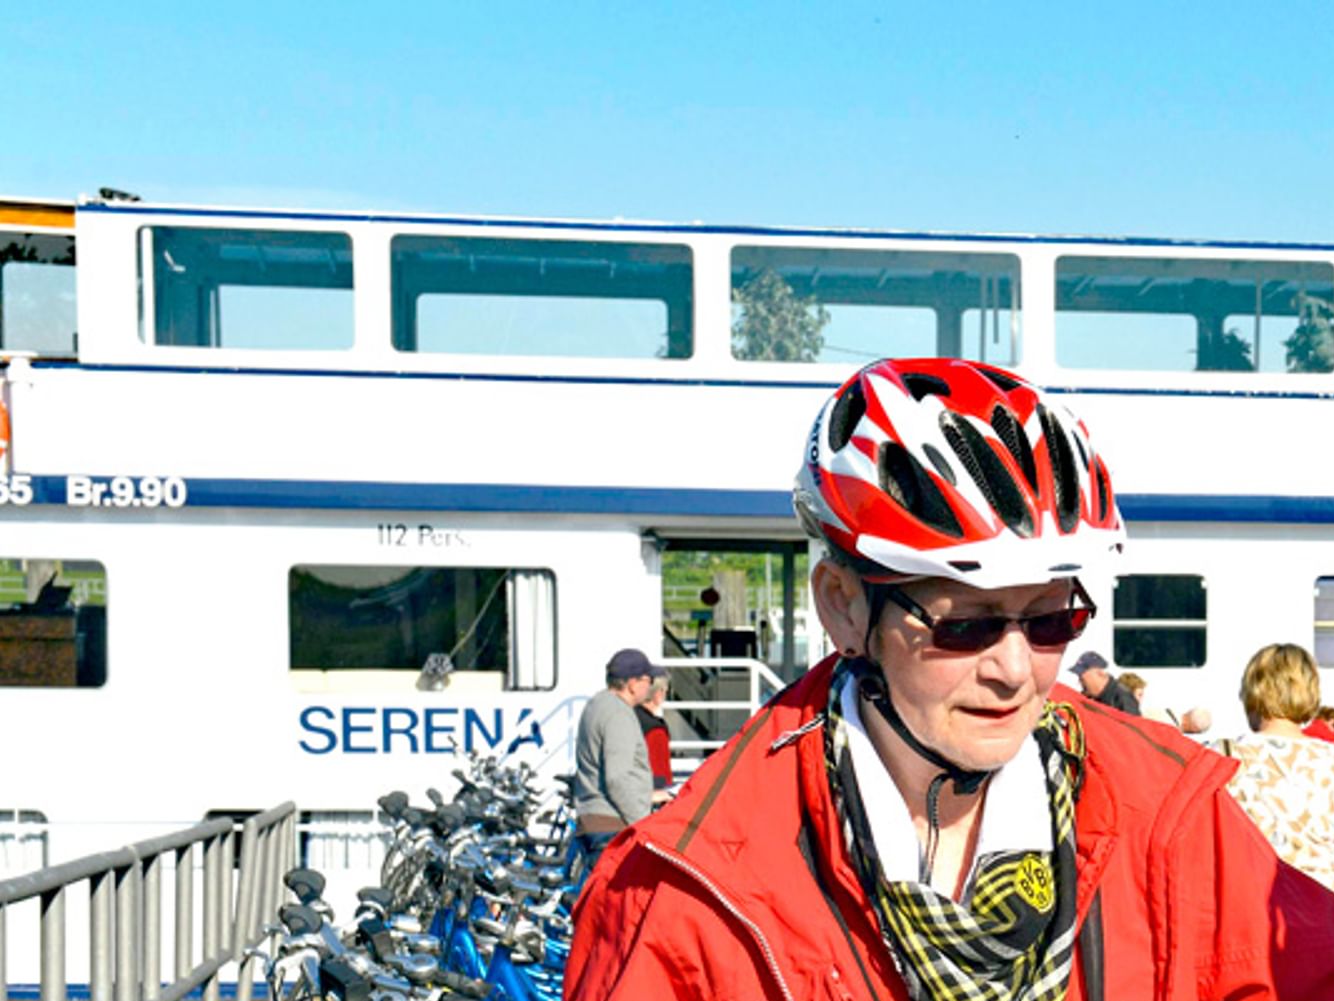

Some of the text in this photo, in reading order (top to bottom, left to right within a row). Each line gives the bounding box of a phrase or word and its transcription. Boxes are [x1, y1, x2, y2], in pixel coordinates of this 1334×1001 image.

[66, 475, 187, 507] Br.9.90
[377, 522, 407, 546] 112
[298, 705, 544, 754] SERENA
